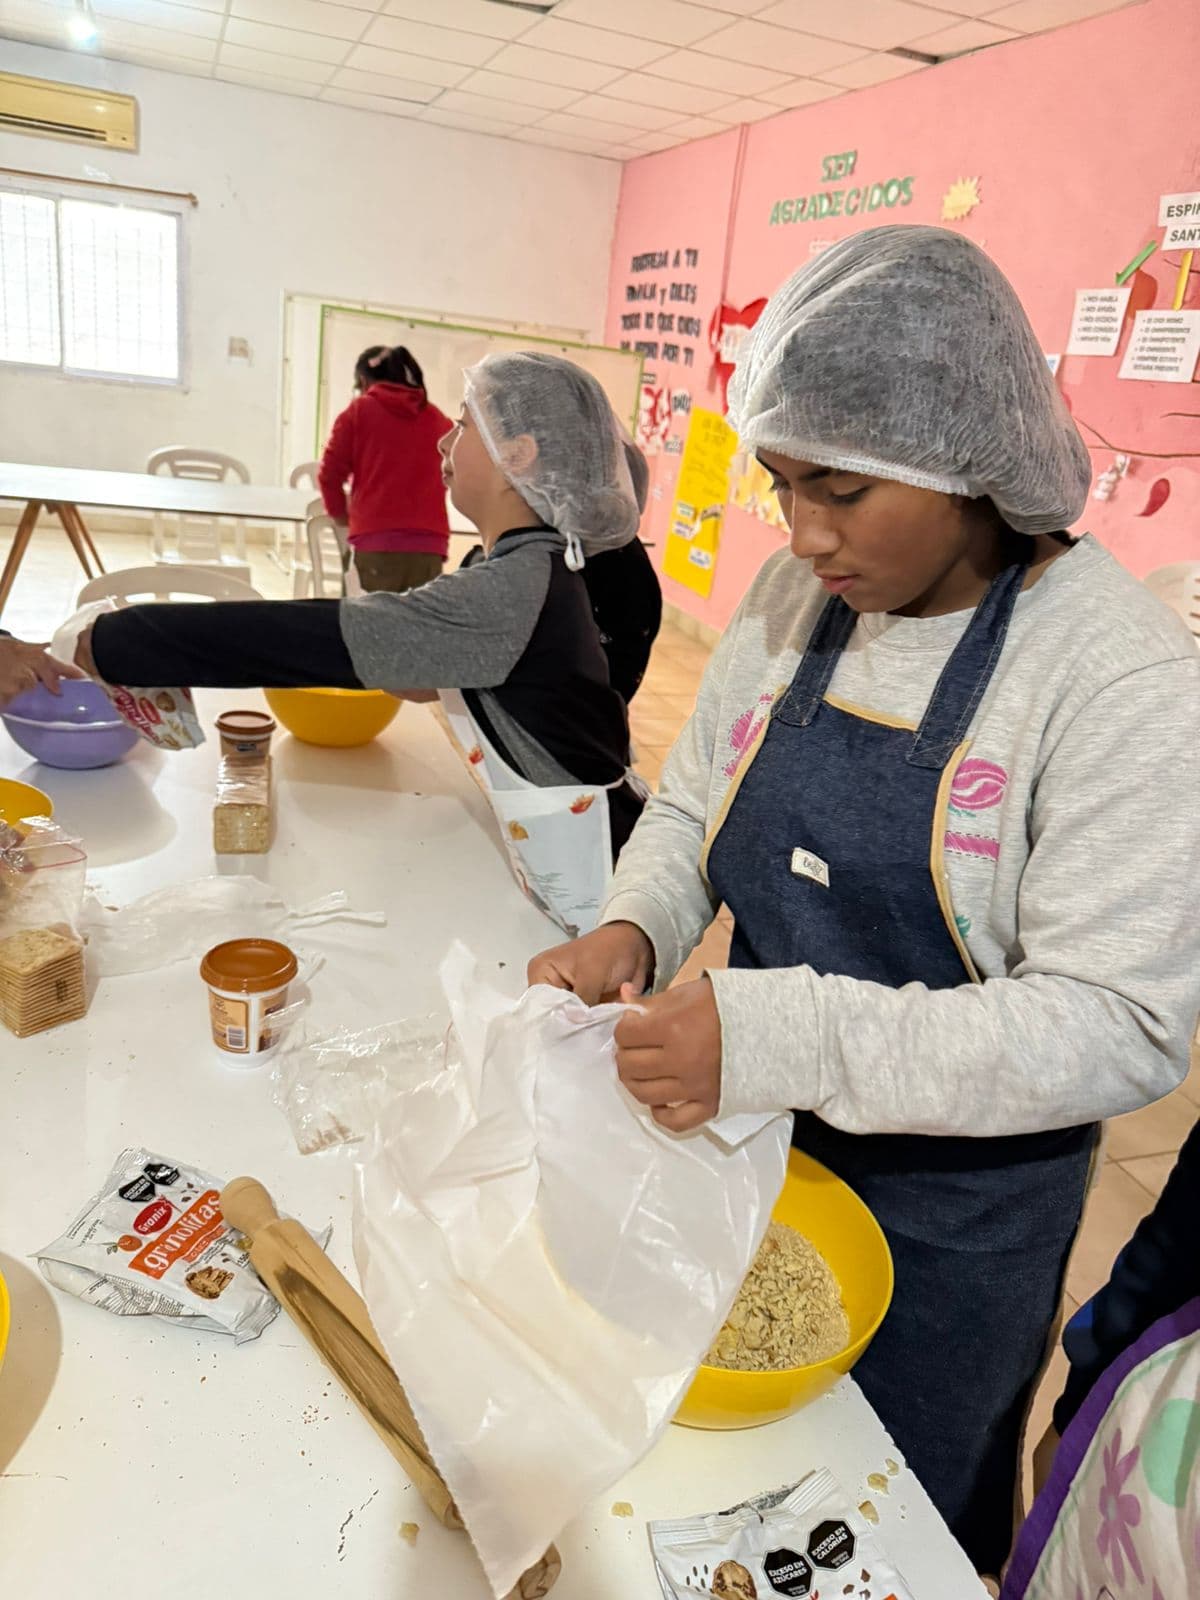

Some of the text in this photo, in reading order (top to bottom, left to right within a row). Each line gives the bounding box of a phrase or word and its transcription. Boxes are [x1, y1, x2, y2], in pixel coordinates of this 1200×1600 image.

[821, 150, 857, 182] SER
[770, 176, 915, 226] AGRADECIDOS
[137, 1206, 167, 1232] Granix
[811, 1526, 846, 1557] EXCESO EN
[768, 1560, 805, 1577] EXCESO EN
